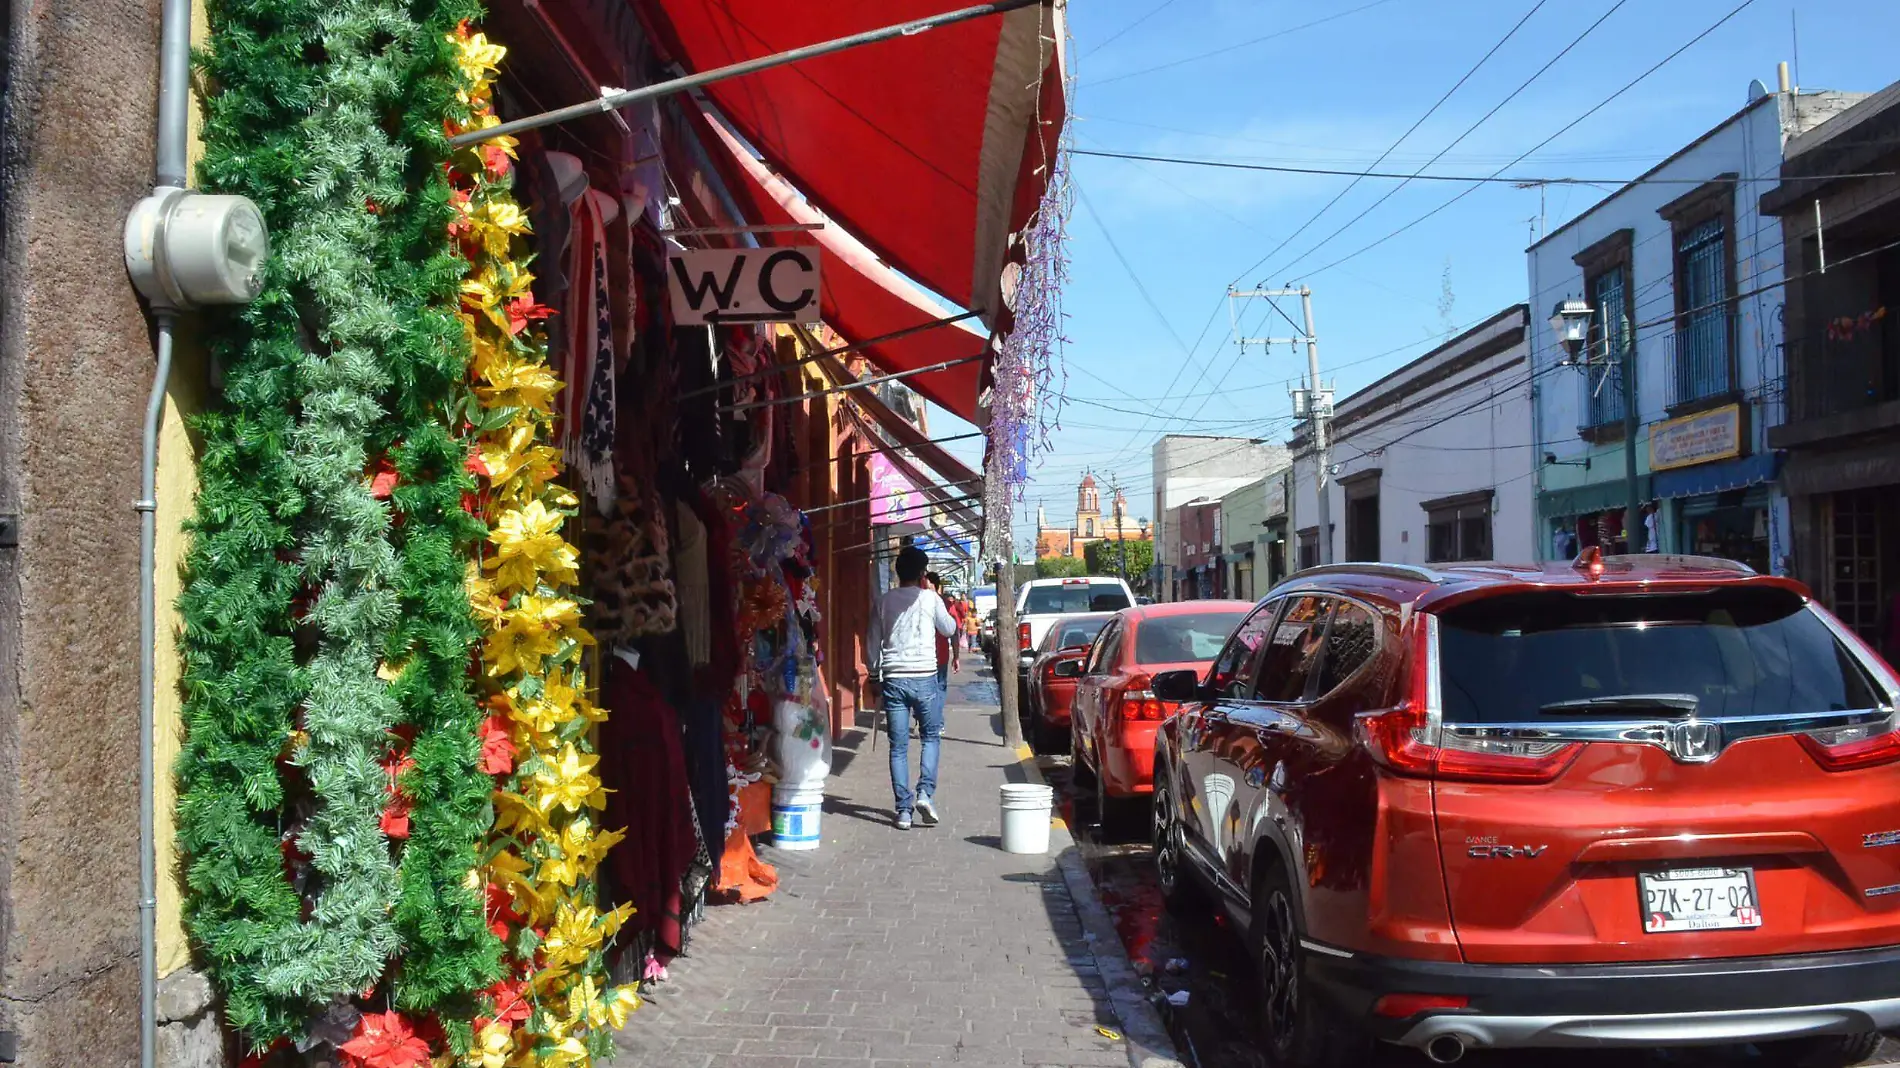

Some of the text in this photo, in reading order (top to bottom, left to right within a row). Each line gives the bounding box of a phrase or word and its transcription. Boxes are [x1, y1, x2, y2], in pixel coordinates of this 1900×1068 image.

[669, 249, 817, 312] W.C.
[1465, 835, 1498, 844] AVANCE
[1467, 844, 1549, 859] CR-V
